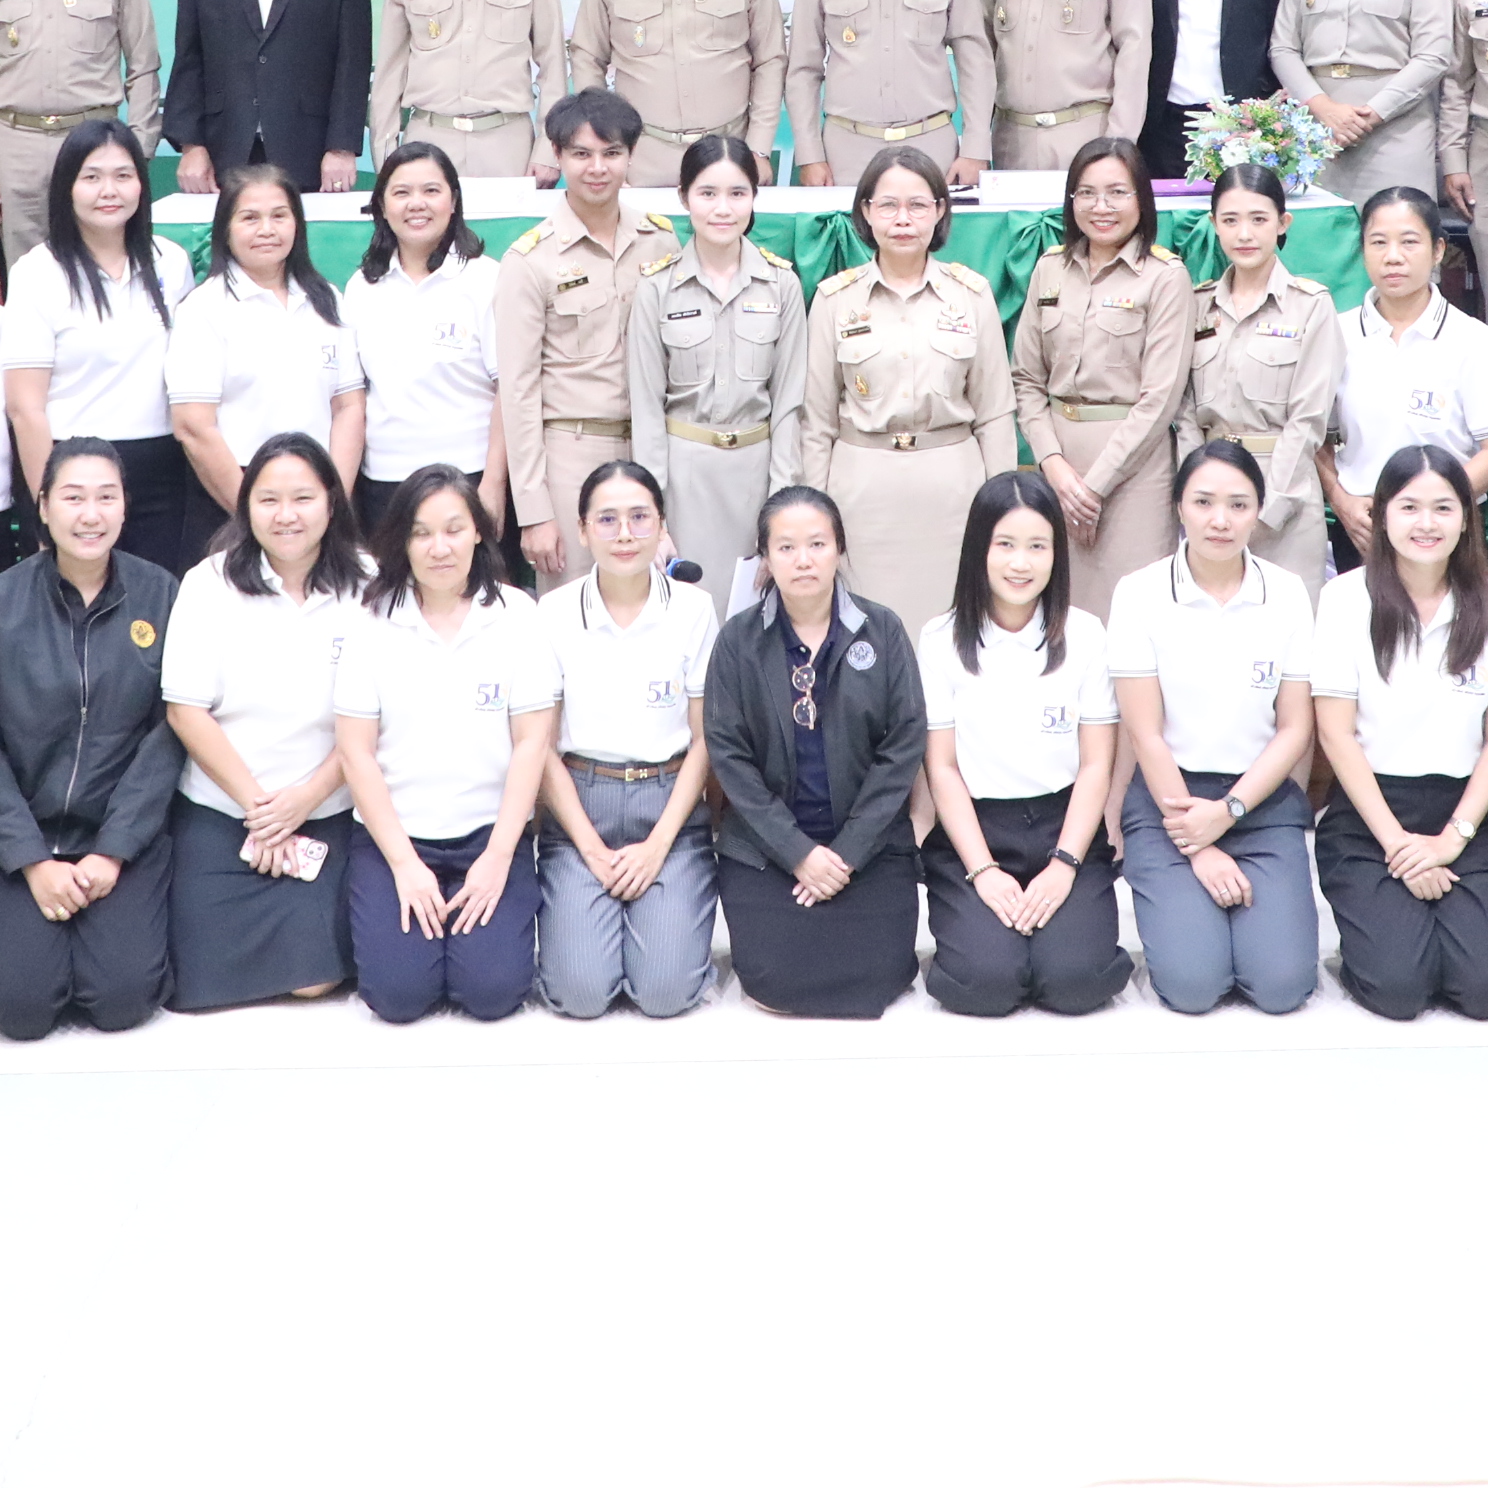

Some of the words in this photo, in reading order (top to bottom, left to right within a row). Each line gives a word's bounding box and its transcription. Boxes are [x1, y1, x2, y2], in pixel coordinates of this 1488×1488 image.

[433, 323, 456, 341] 51
[1408, 389, 1434, 410] 51
[1251, 661, 1274, 684] 51
[475, 683, 500, 706] 51
[646, 680, 671, 703] 51
[1041, 705, 1066, 728] 51
